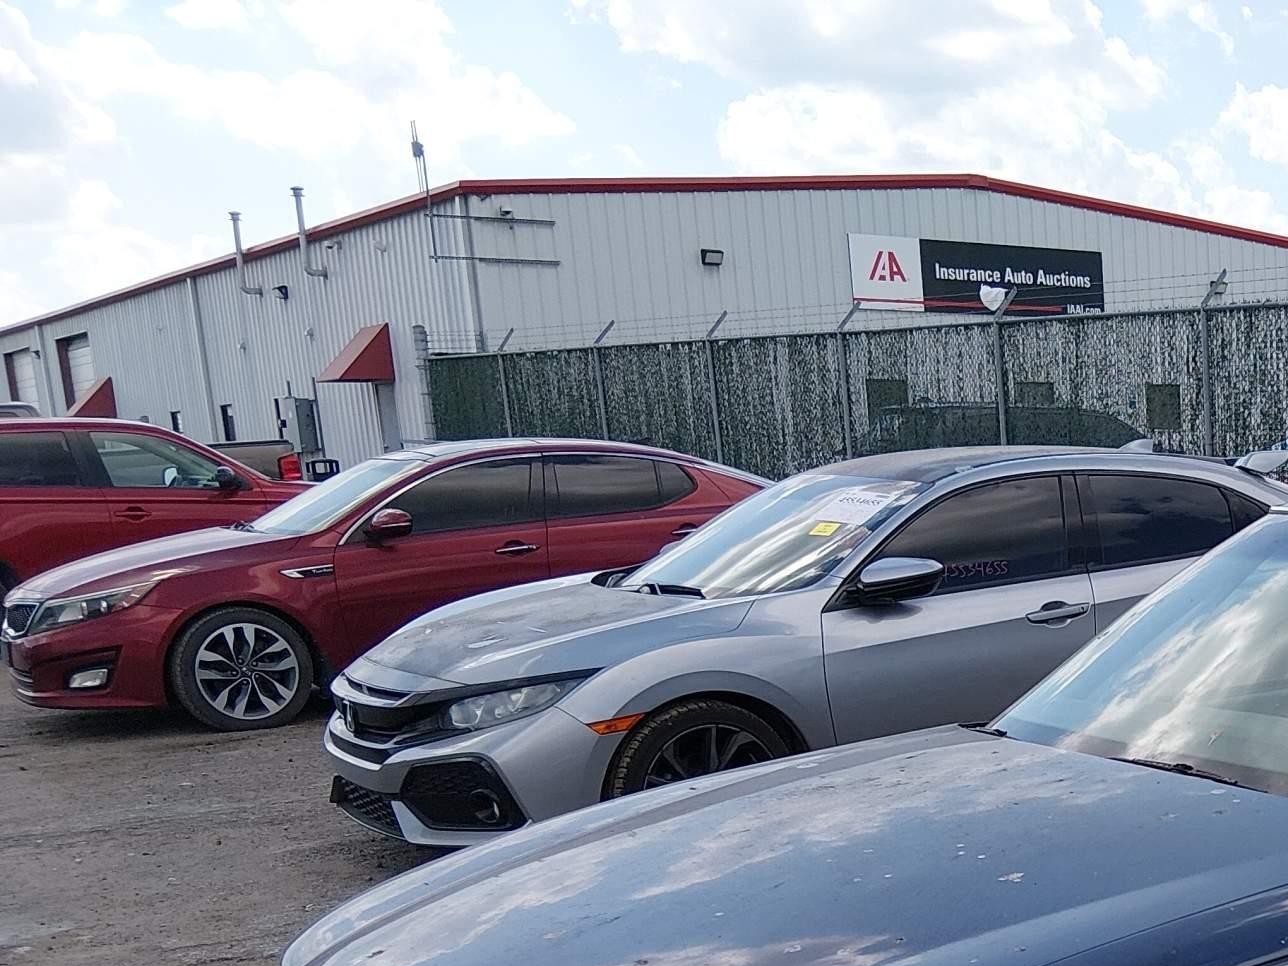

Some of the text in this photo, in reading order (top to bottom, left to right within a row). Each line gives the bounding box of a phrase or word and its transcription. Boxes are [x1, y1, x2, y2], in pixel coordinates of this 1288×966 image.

[935, 263, 1091, 288] Insurance Auto Auctions
